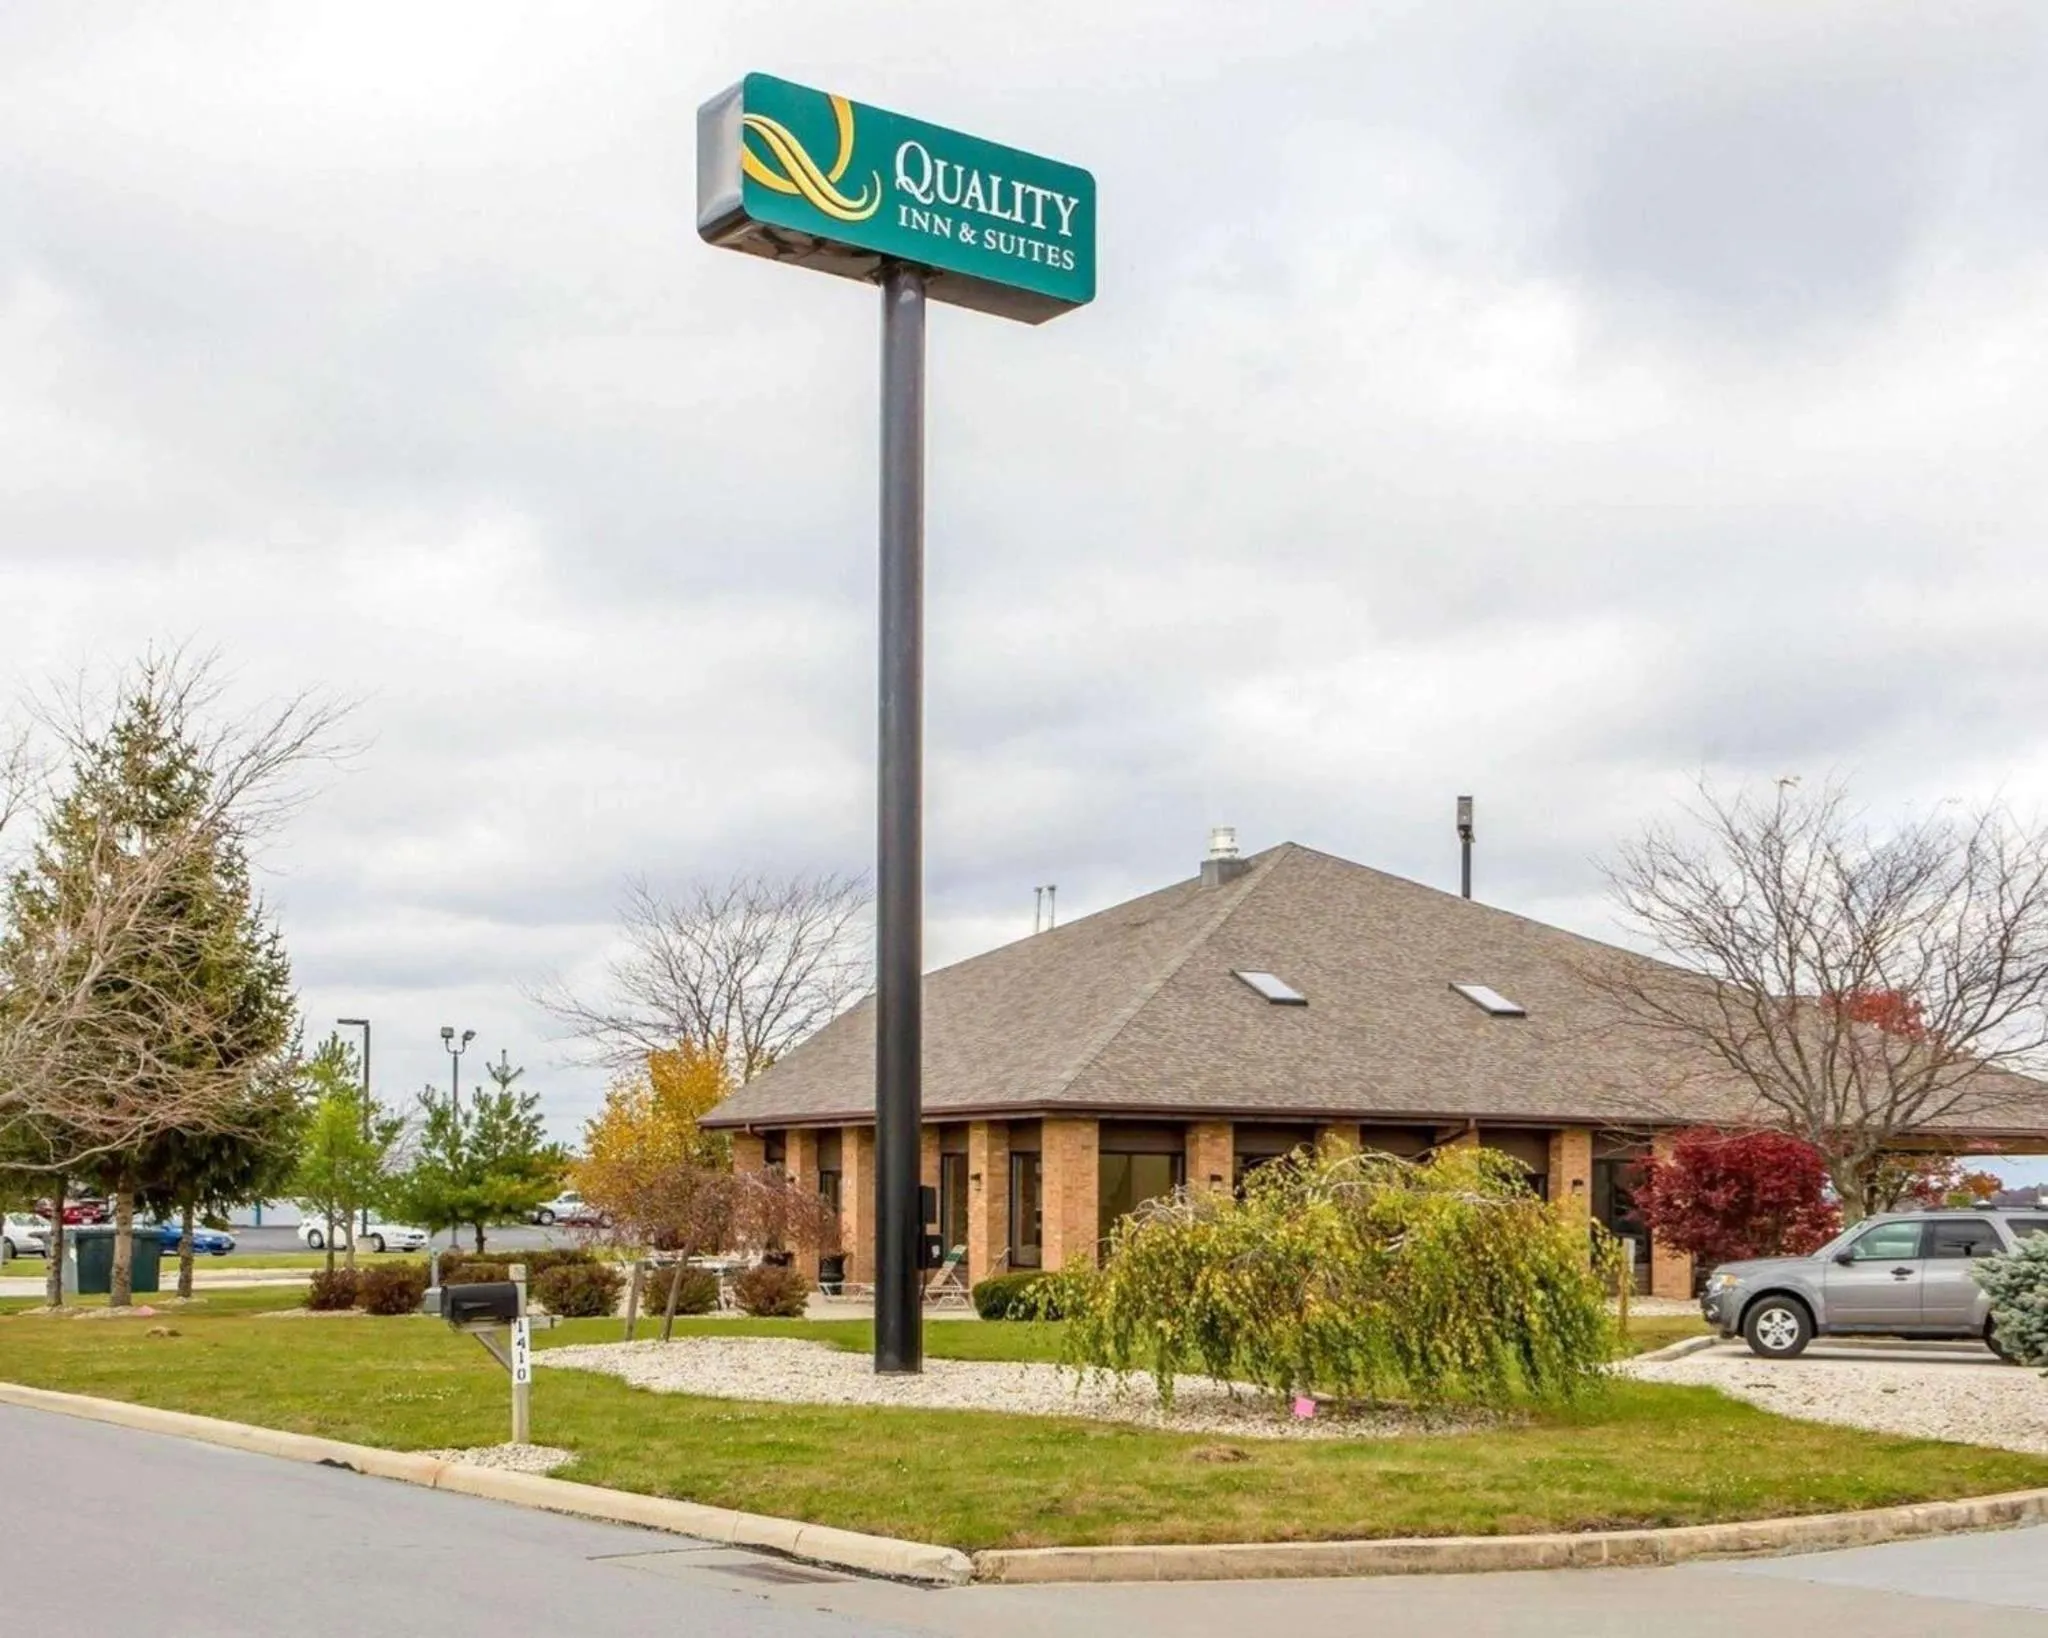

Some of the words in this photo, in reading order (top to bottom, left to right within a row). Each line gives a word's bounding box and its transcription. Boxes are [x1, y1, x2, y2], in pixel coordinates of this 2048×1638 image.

[896, 141, 1078, 236] QUALITY
[899, 205, 951, 238] INN
[959, 222, 977, 245] &
[984, 229, 1075, 270] SUITES
[516, 1320, 526, 1380] 1410
